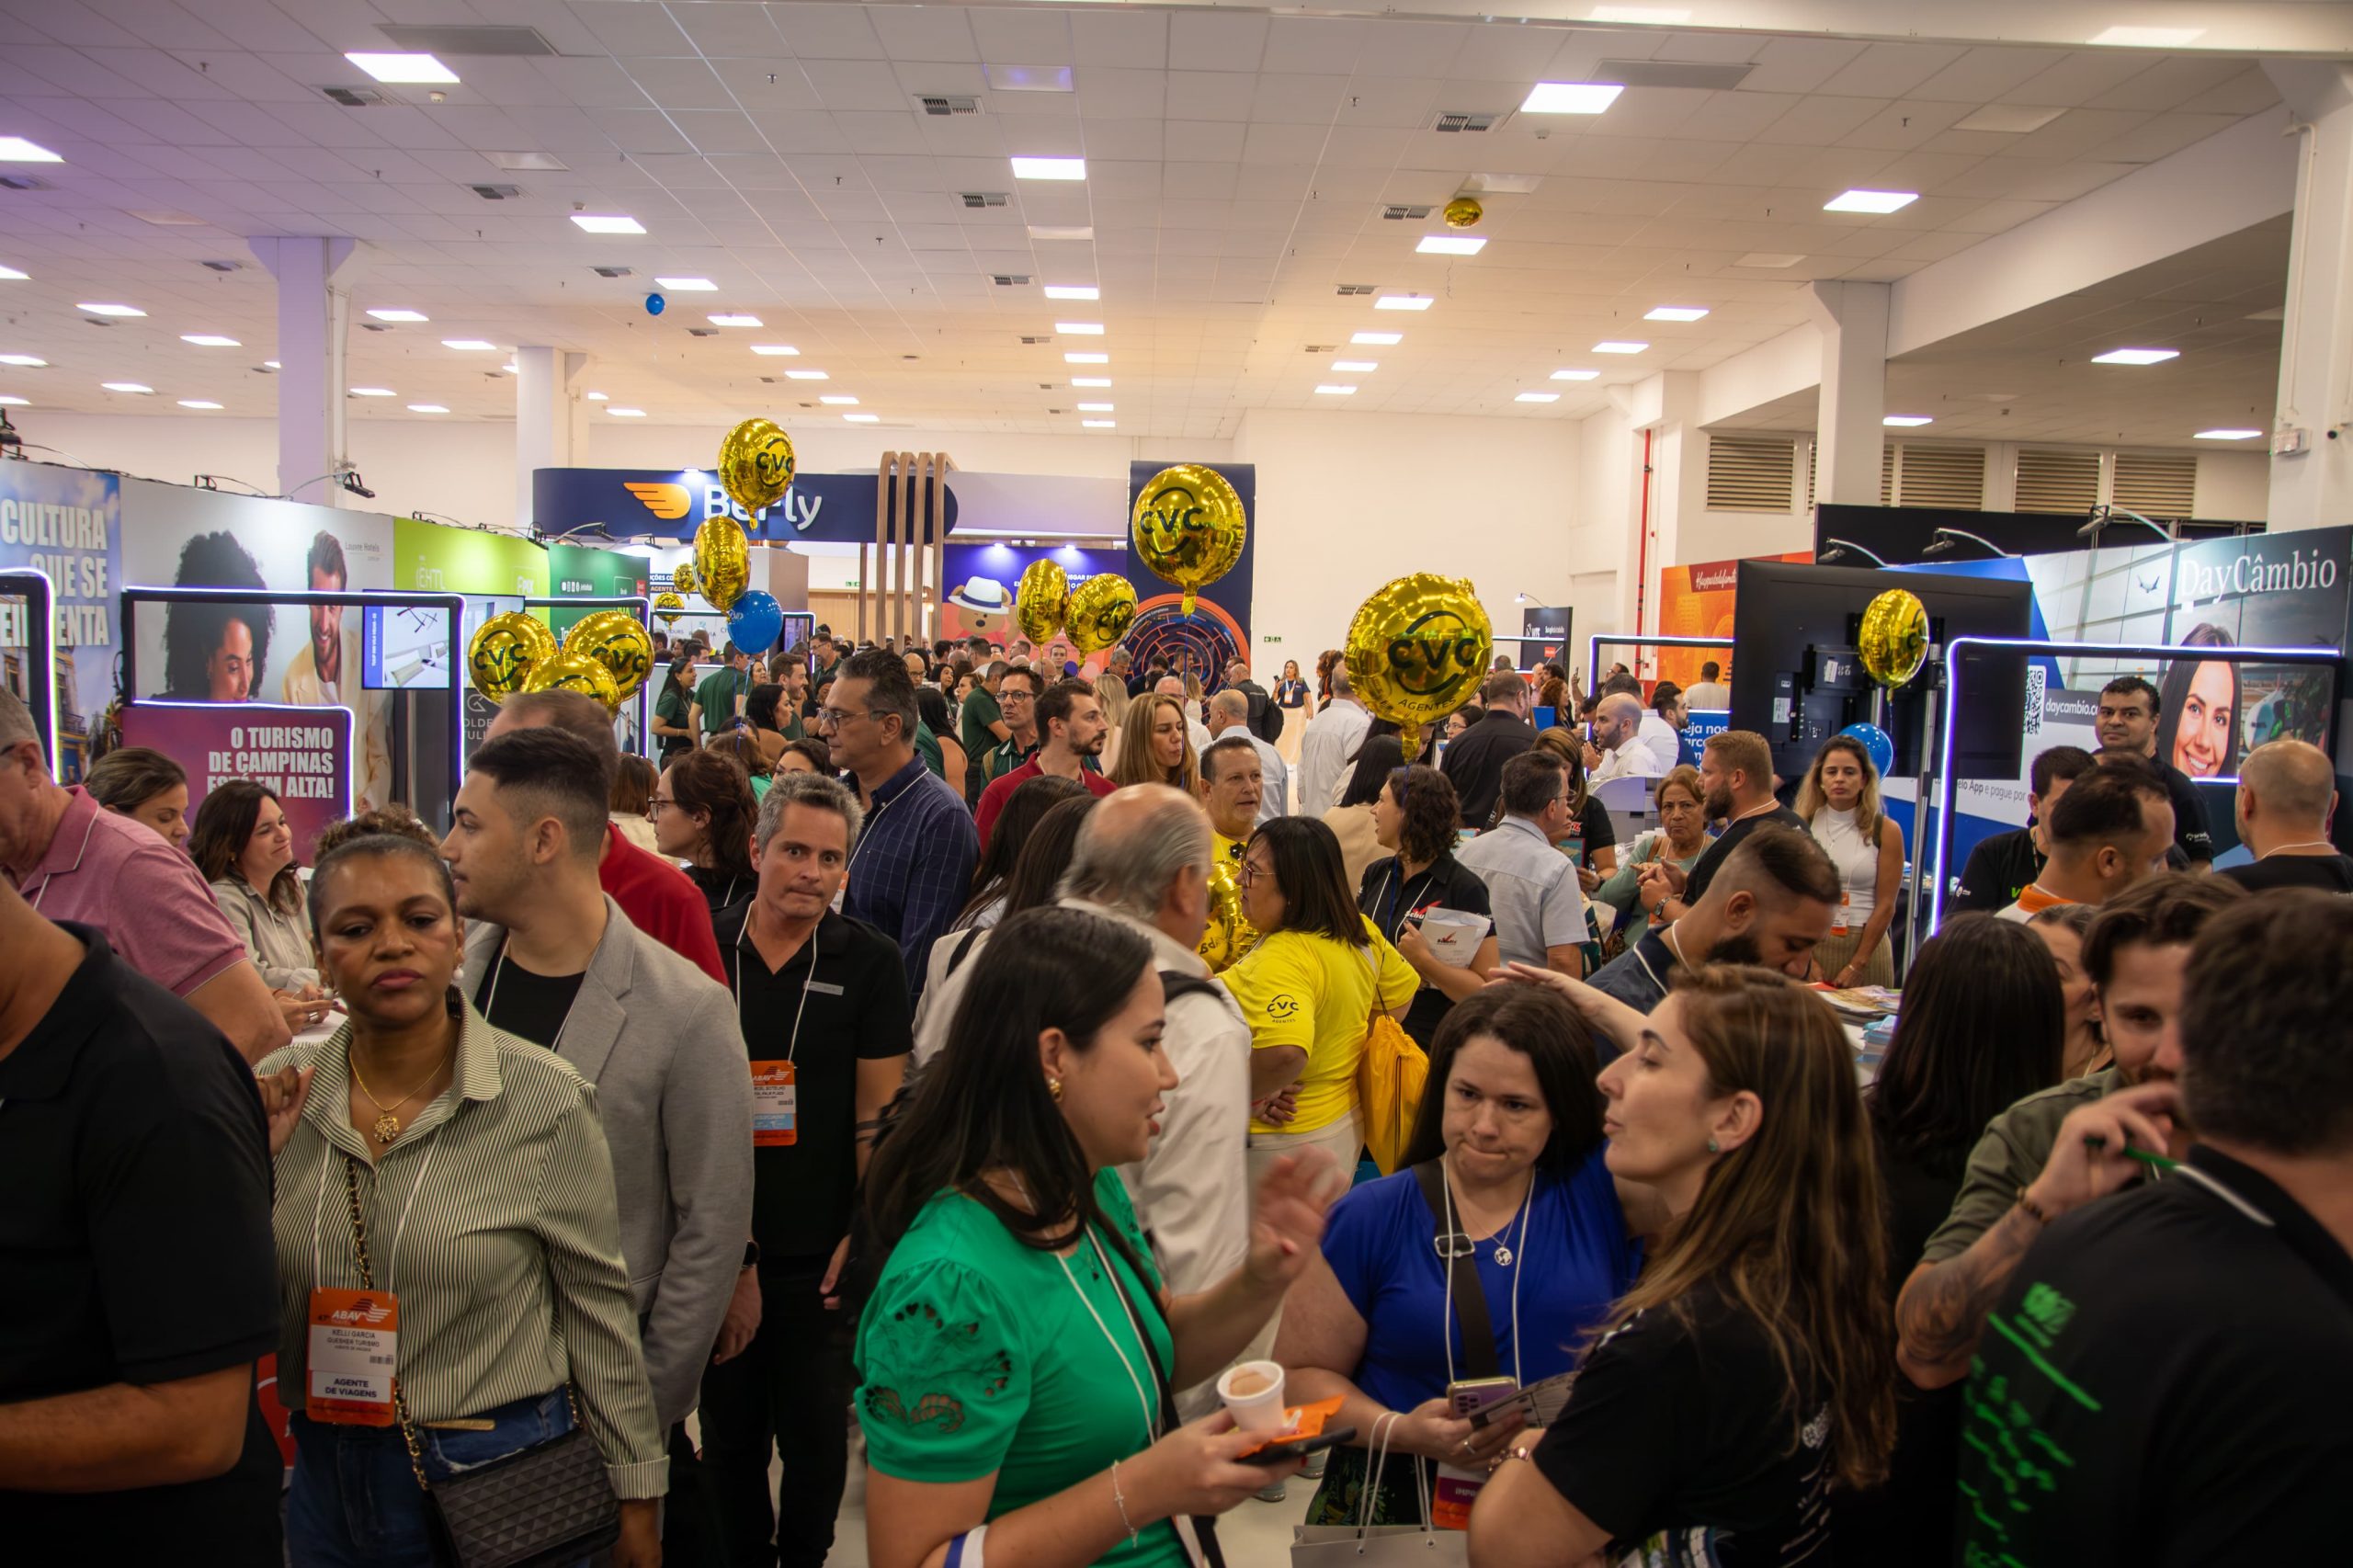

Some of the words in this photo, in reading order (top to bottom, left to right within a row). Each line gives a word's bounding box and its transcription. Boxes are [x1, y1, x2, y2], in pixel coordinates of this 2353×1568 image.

[1, 498, 108, 551] CULTURA
[1140, 507, 1204, 535] CVC
[80, 556, 108, 598] SE
[473, 643, 528, 671] CVC
[1388, 638, 1476, 669] CVC
[1398, 698, 1457, 712] AGENTES
[231, 727, 244, 749] O
[247, 727, 334, 750] TURISMO
[209, 751, 233, 773] DE
[235, 751, 334, 775] CAMPINAS
[286, 776, 335, 799] ALTA!
[1969, 781, 1984, 793] App
[1267, 1001, 1300, 1013] CVC
[331, 1310, 361, 1321] ABAV
[352, 1331, 376, 1339] GARCIA
[356, 1339, 380, 1347] TURISMO
[334, 1379, 369, 1387] AGENTE
[339, 1388, 377, 1398] VIAGENS
